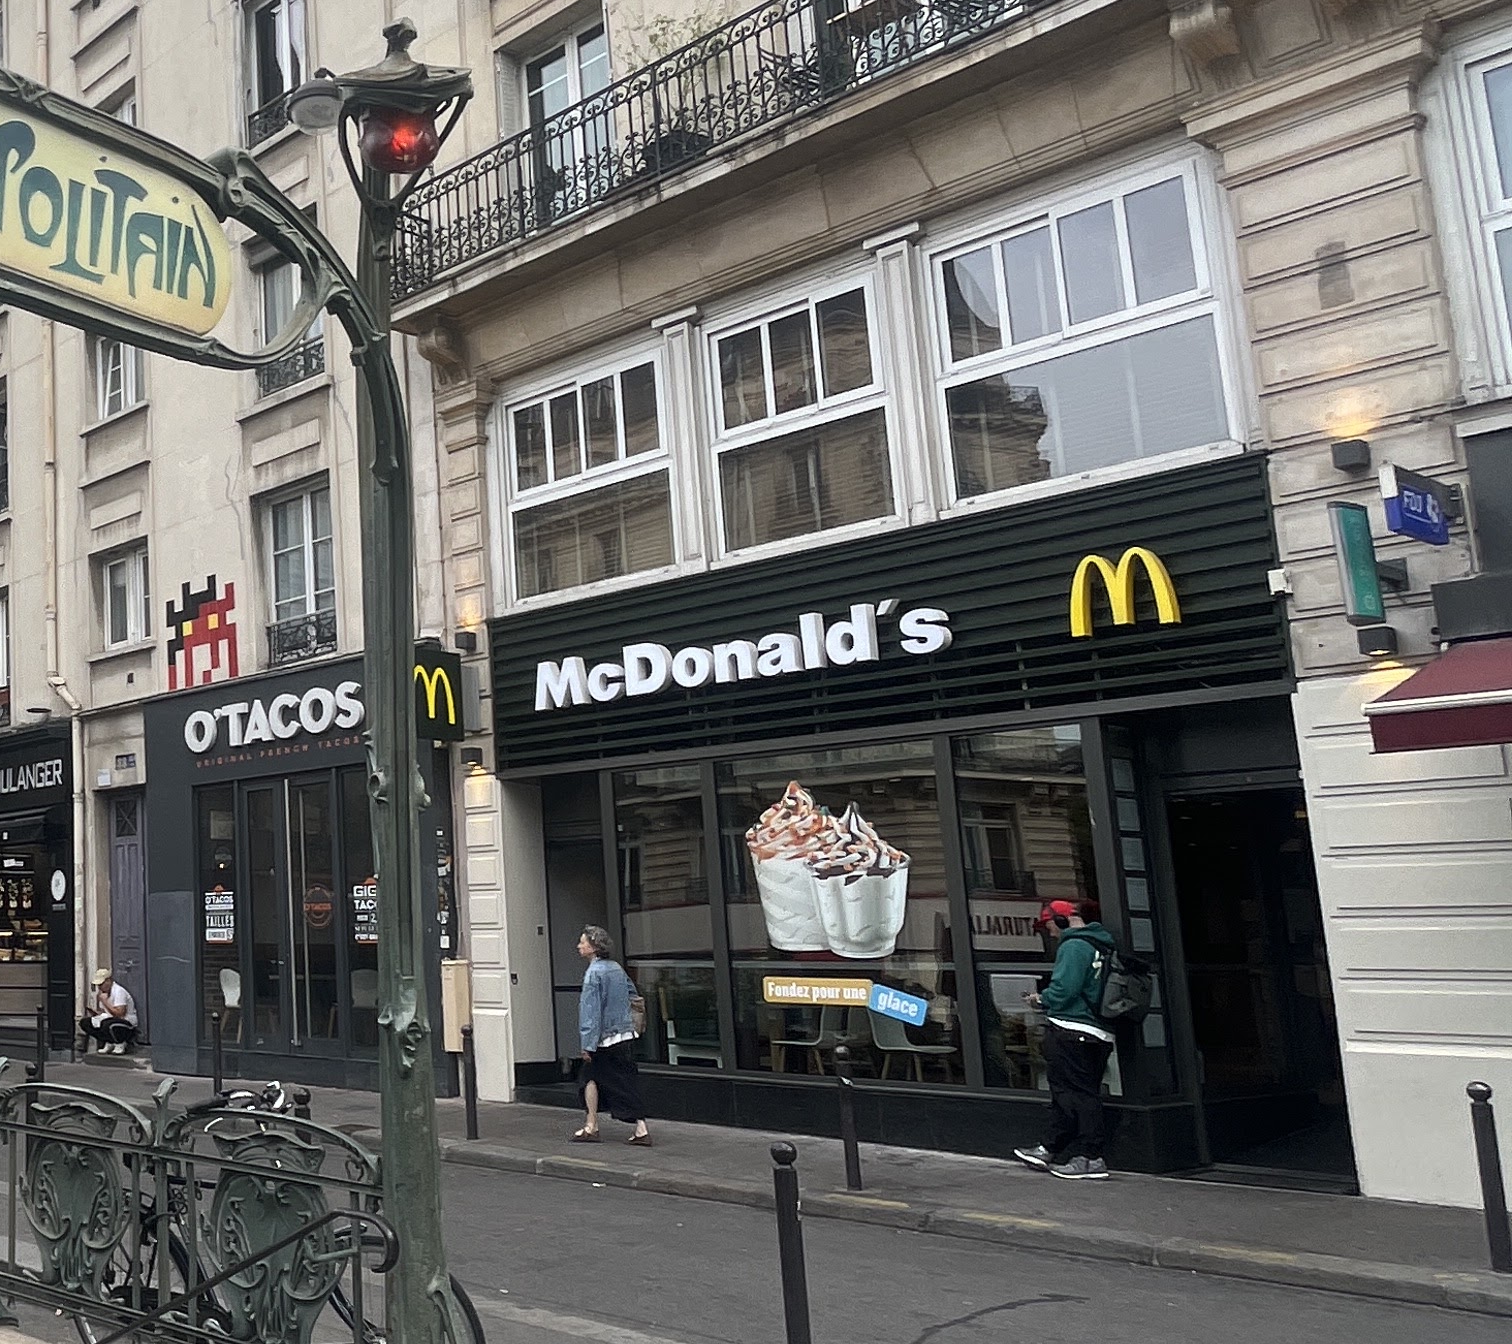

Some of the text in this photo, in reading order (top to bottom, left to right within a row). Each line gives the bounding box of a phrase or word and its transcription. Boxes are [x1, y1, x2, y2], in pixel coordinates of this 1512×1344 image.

[534, 598, 953, 712] McDonald's
[184, 680, 365, 753] O'TACOS
[317, 735, 361, 750] TACOS
[353, 885, 377, 897] GIG
[353, 899, 378, 910] TAC
[767, 981, 867, 1002] Fondez pour une
[877, 990, 919, 1018] glace
